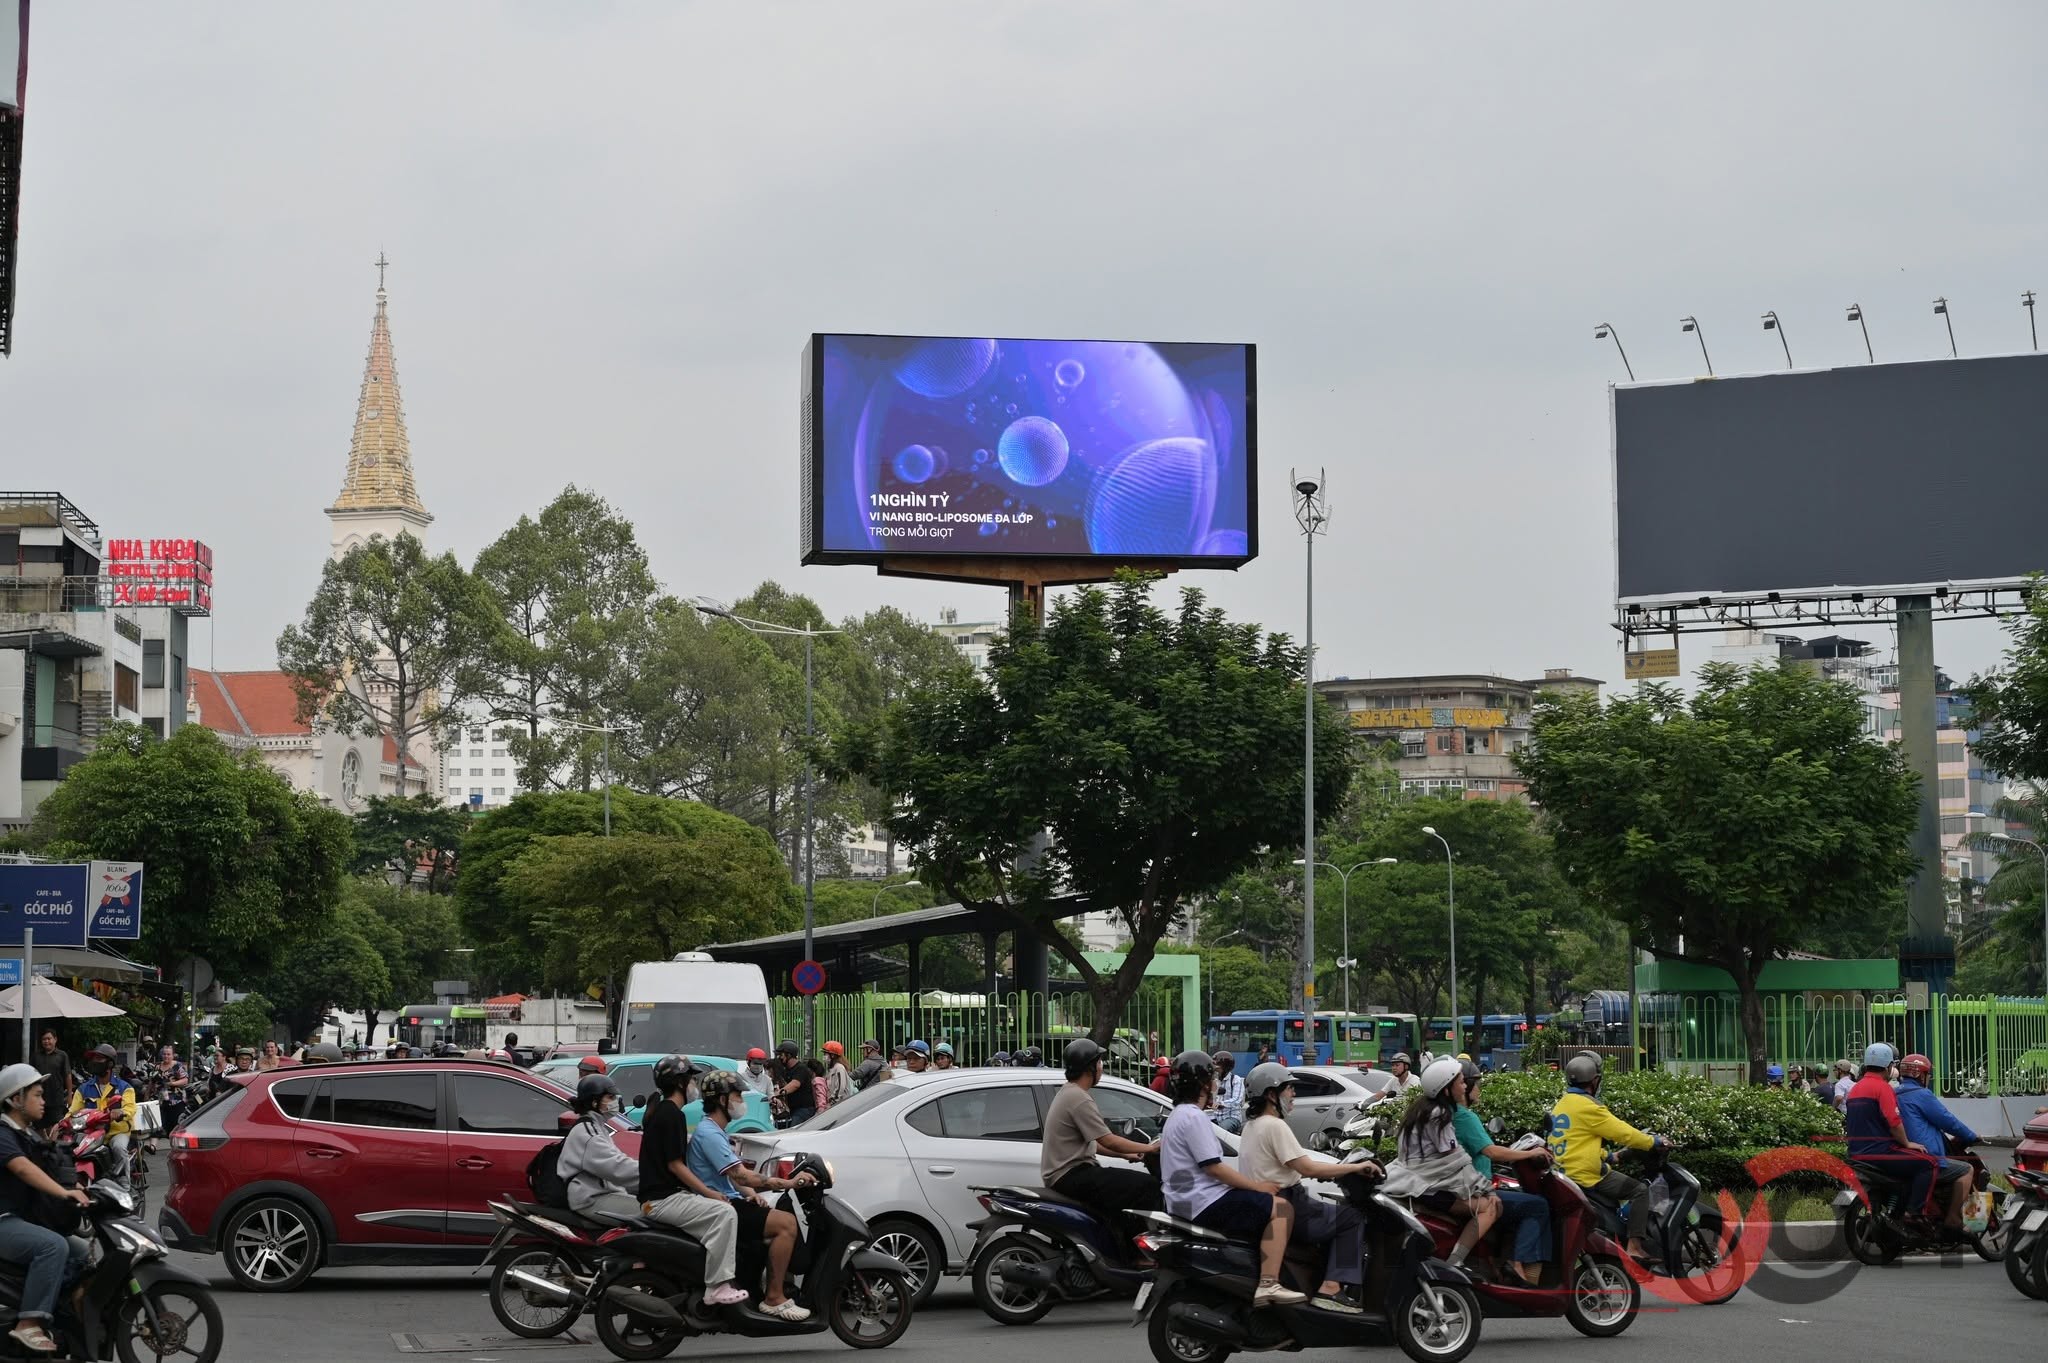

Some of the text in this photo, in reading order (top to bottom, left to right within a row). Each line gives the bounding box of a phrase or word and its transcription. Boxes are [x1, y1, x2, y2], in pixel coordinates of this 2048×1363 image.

[869, 490, 950, 508] 1NGHÌN TỶ
[869, 512, 1034, 524] VI NANG BIO-LIPOSOME ĐA LỚP
[869, 524, 954, 539] TRONG MỖI GIỌT
[108, 539, 197, 561] NHA KHOA
[108, 563, 196, 578] DENTAL CLINIC
[24, 899, 73, 915] GÓC PHỐ
[99, 914, 131, 926] GÓC PHỐ
